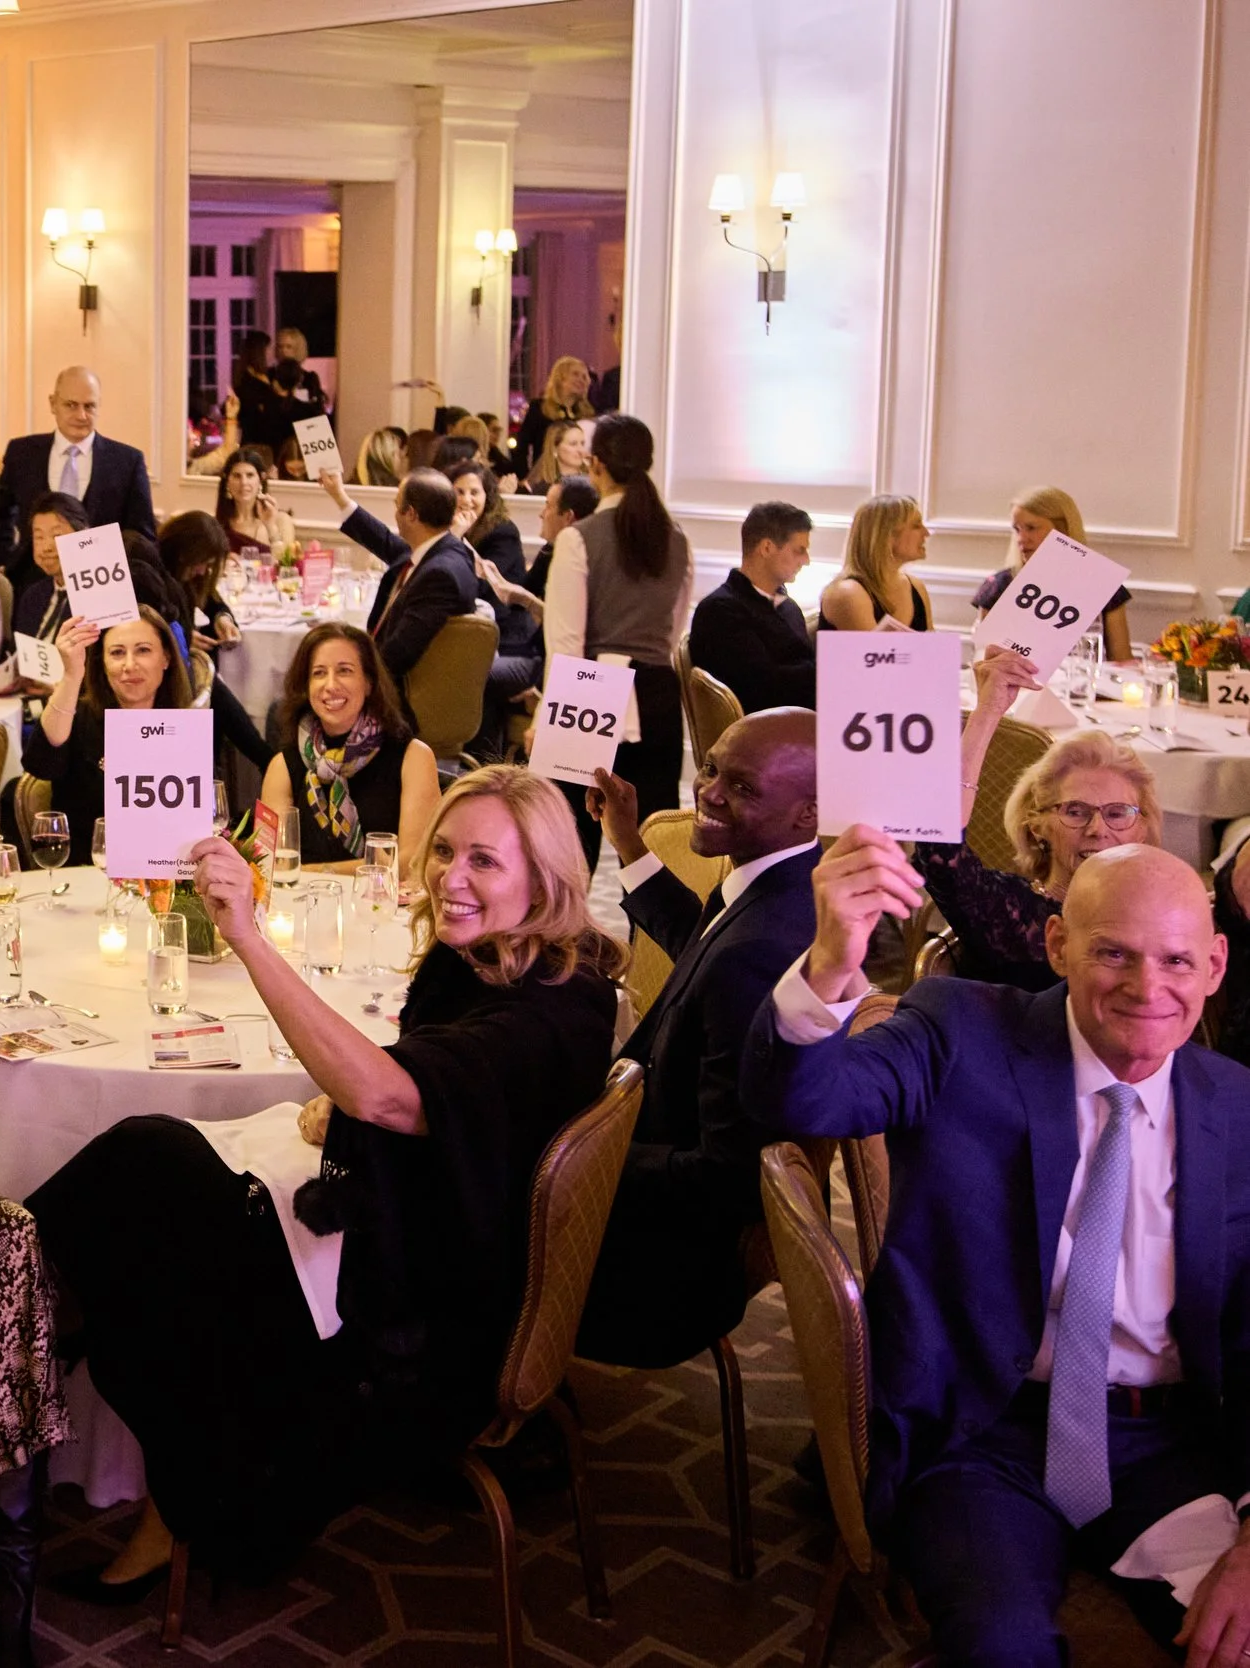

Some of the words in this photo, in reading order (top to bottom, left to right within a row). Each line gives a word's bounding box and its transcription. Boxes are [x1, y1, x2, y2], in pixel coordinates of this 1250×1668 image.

[302, 437, 335, 456] 2506
[68, 562, 125, 592] 1506
[36, 643, 51, 678] 1401
[864, 648, 896, 668] gwi
[576, 670, 597, 681] gwi
[1218, 685, 1250, 705] 24
[140, 722, 164, 739] gwi
[547, 701, 617, 738] 1502
[842, 711, 934, 755] 610
[114, 774, 201, 809] 1501
